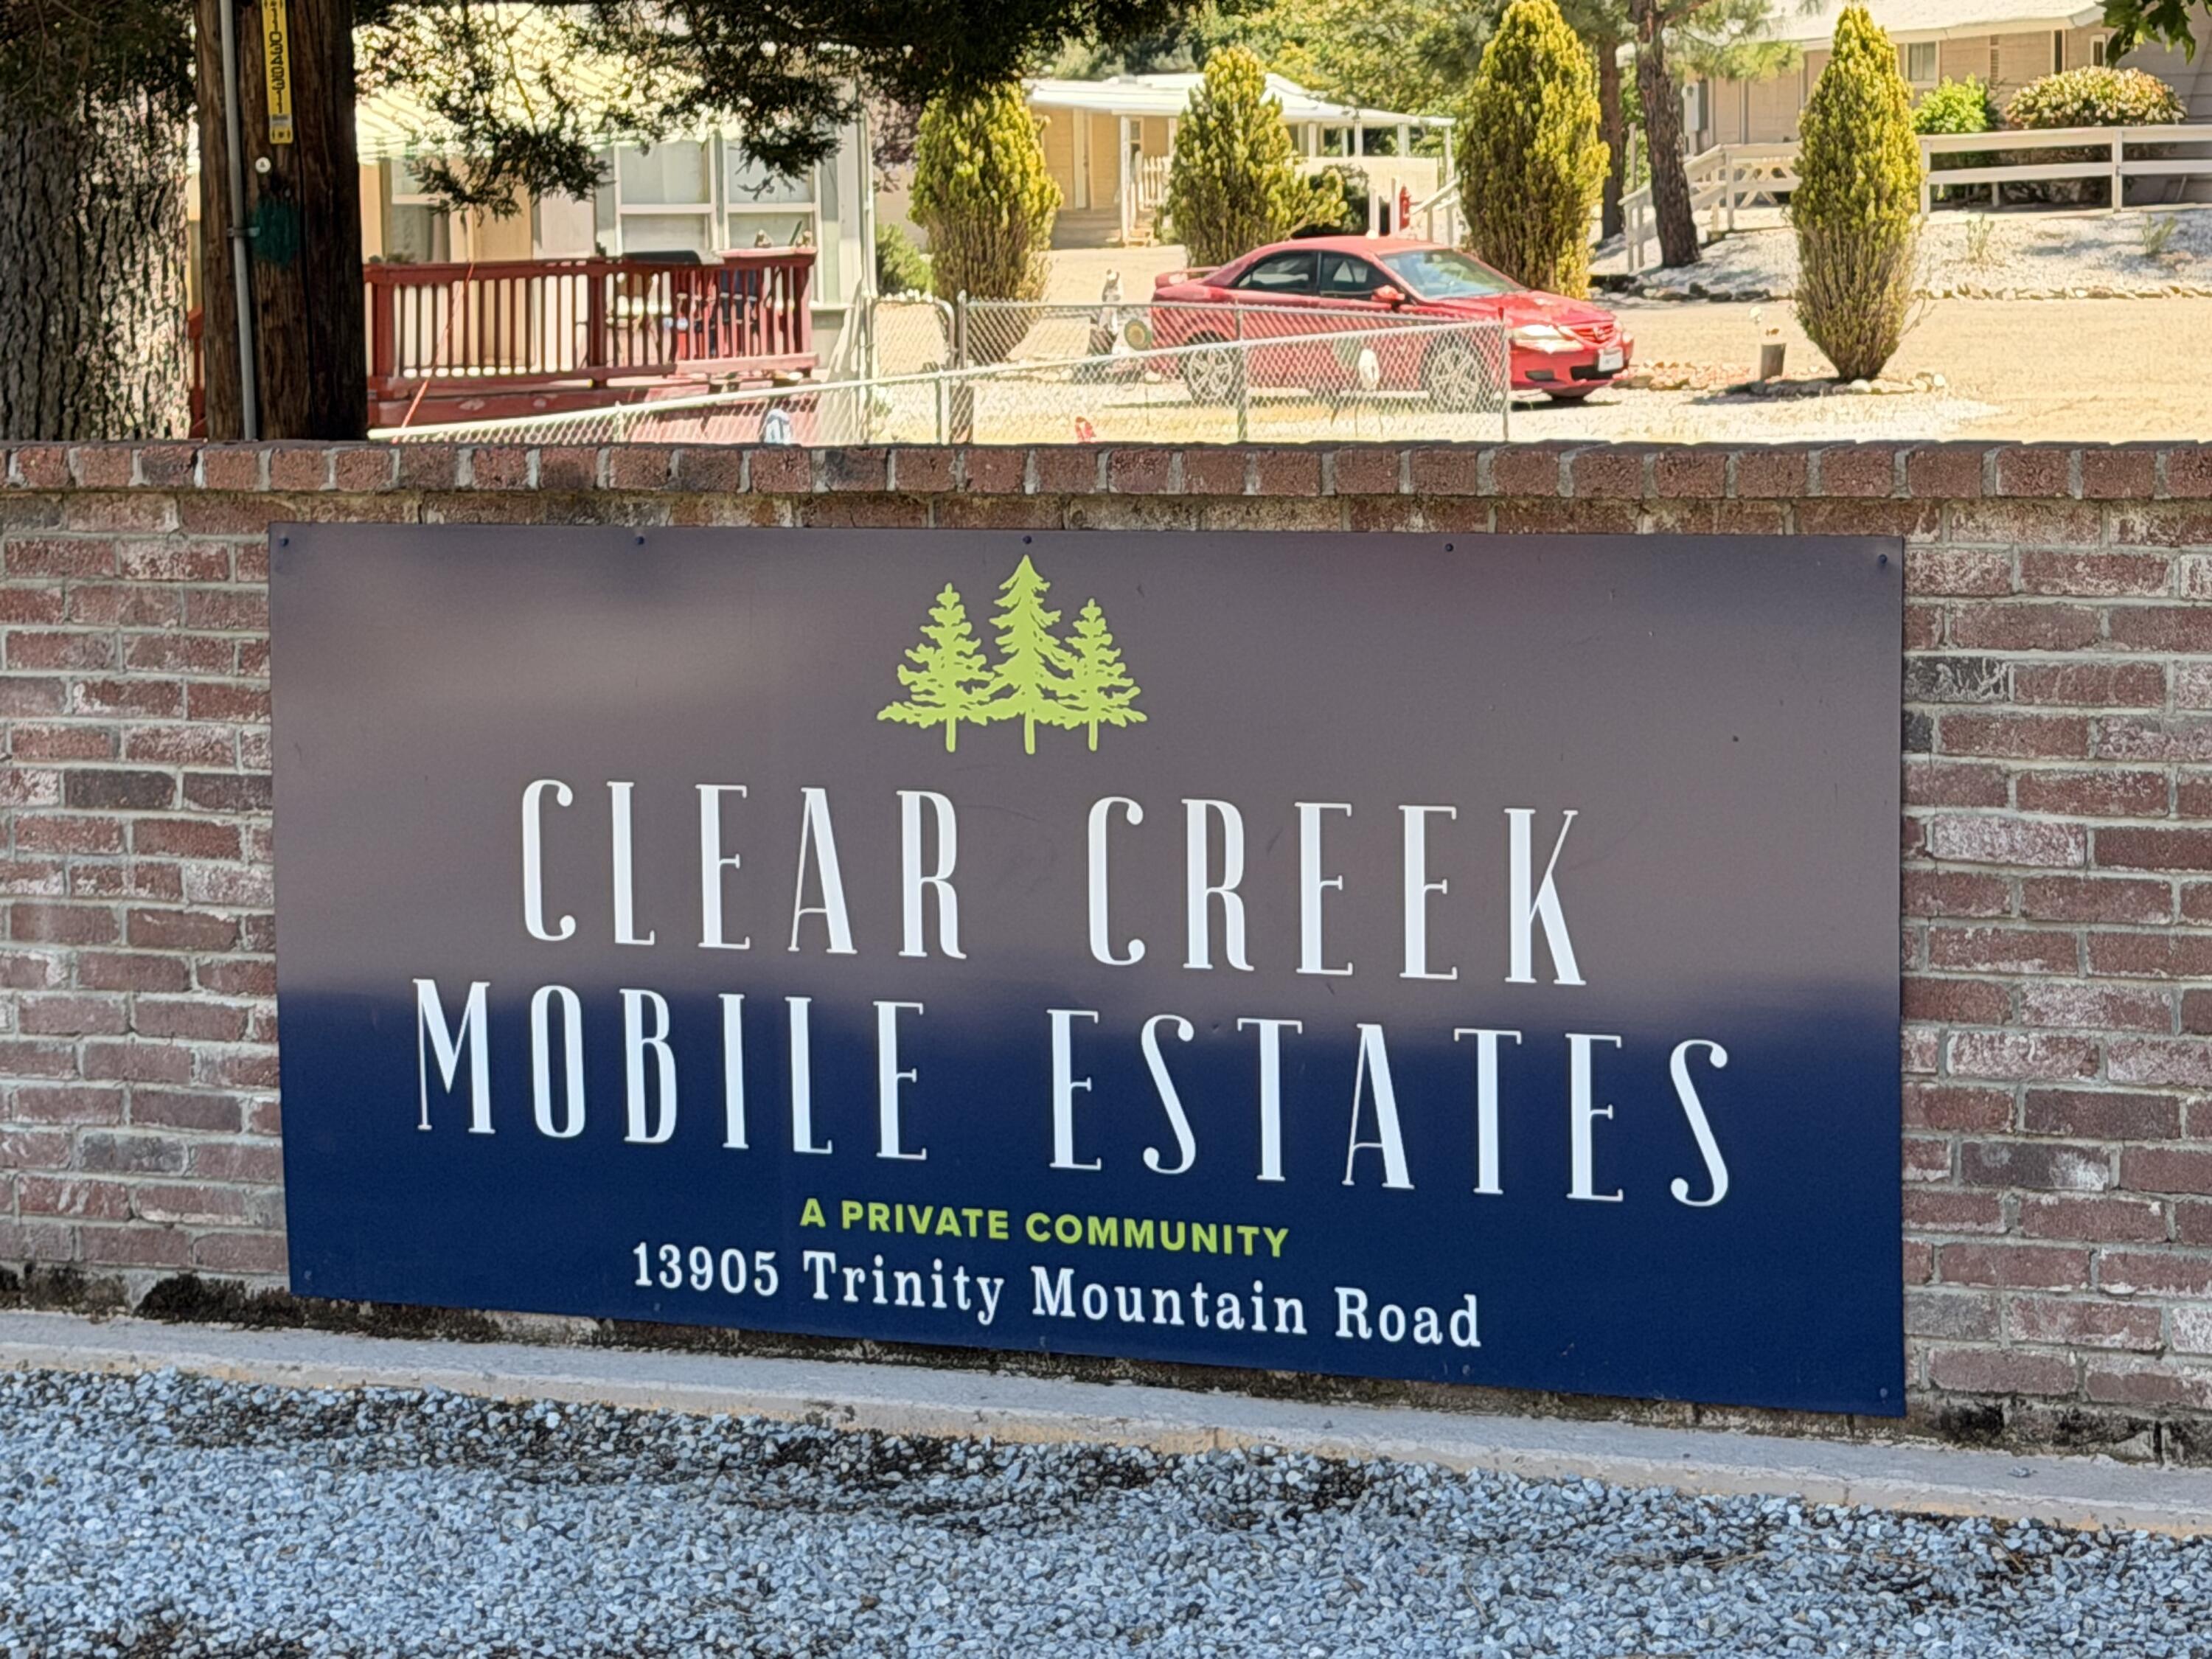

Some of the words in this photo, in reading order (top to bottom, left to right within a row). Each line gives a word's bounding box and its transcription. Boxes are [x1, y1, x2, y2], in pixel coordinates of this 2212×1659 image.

[521, 778, 967, 961] CLEAR
[1086, 795, 1587, 987] CREEK
[411, 977, 928, 1162] MOBILE
[1046, 1007, 1731, 1208] ESTATES
[632, 1241, 779, 1297] 13905
[802, 1249, 1005, 1326] Trinity
[1030, 1265, 1308, 1335] Mountain
[1334, 1286, 1482, 1348] Road
[799, 1197, 827, 1228] A
[841, 1200, 1009, 1240] PRIVATE
[1025, 1211, 1289, 1258] COMMUNITY
